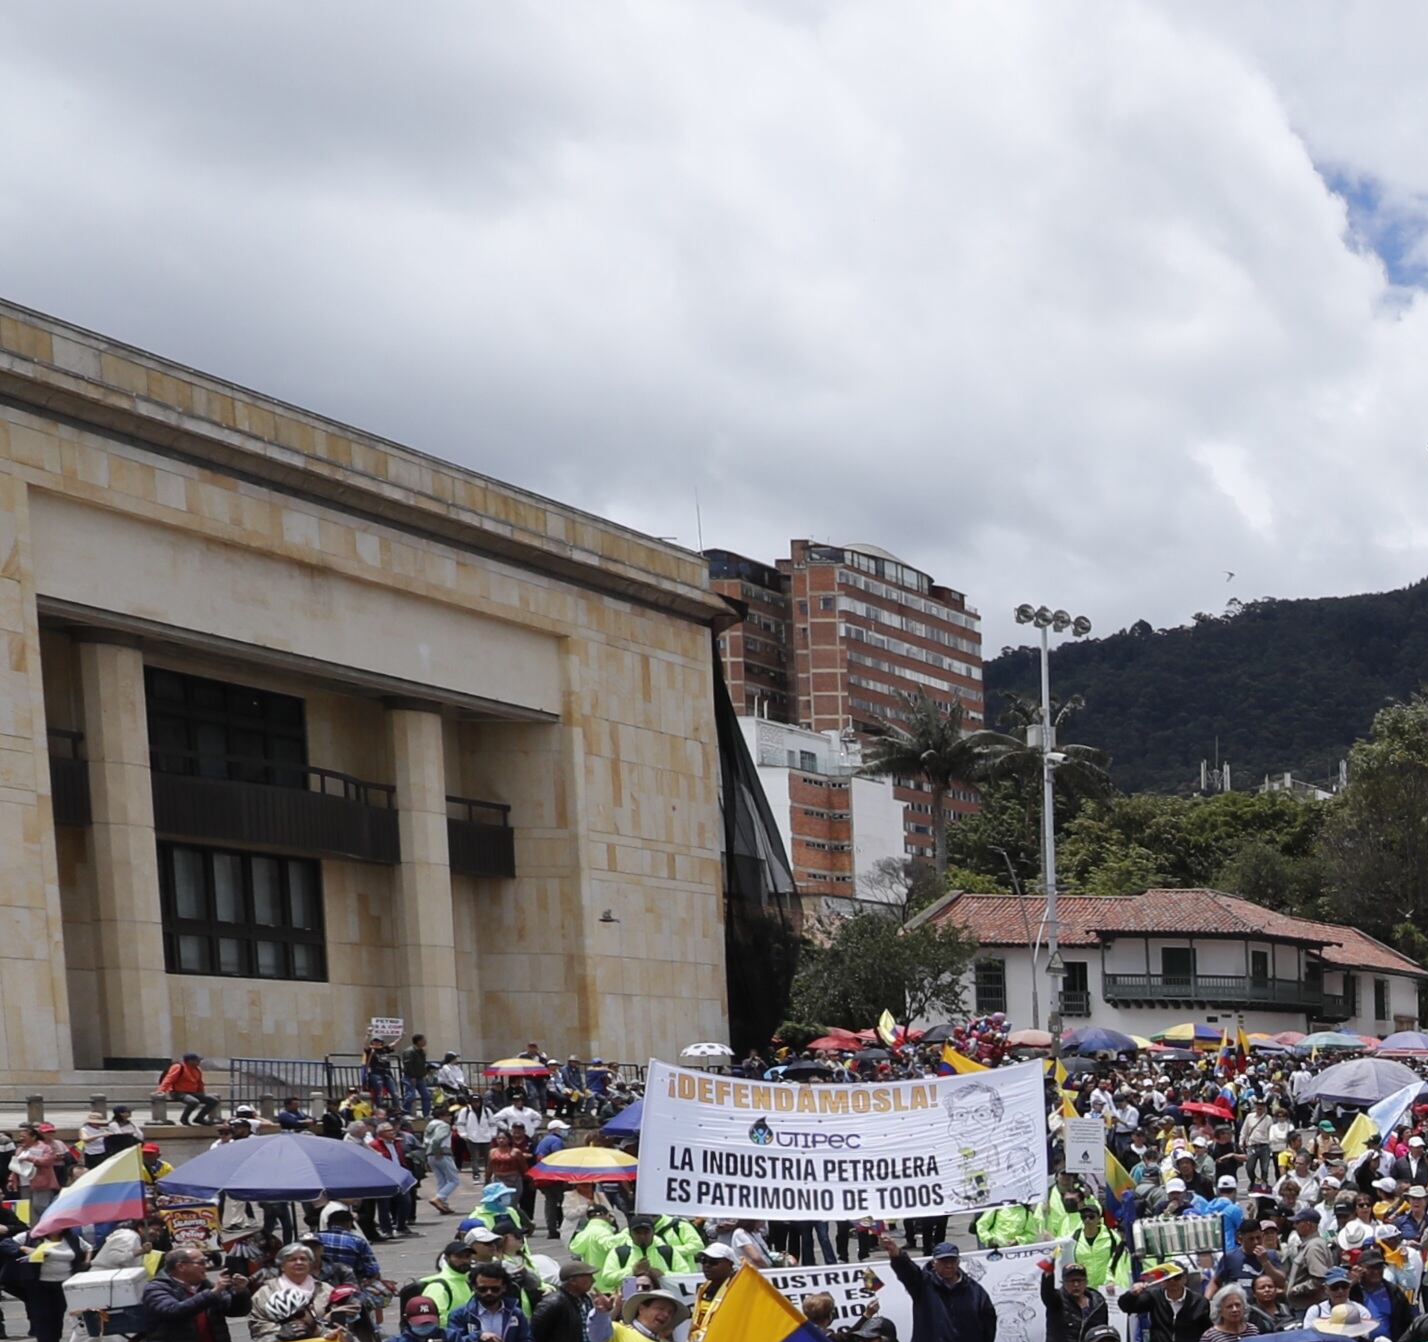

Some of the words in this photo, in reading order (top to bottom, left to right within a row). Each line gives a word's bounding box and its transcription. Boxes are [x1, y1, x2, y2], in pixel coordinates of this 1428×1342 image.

[669, 1146, 694, 1172] LA
[702, 1150, 817, 1182] INDUSTRIA
[823, 1155, 939, 1183] PETROLERA
[666, 1178, 691, 1203] ES
[697, 1180, 834, 1211] PATRIMONIO
[843, 1189, 869, 1210] DE
[877, 1183, 945, 1210] TODOS
